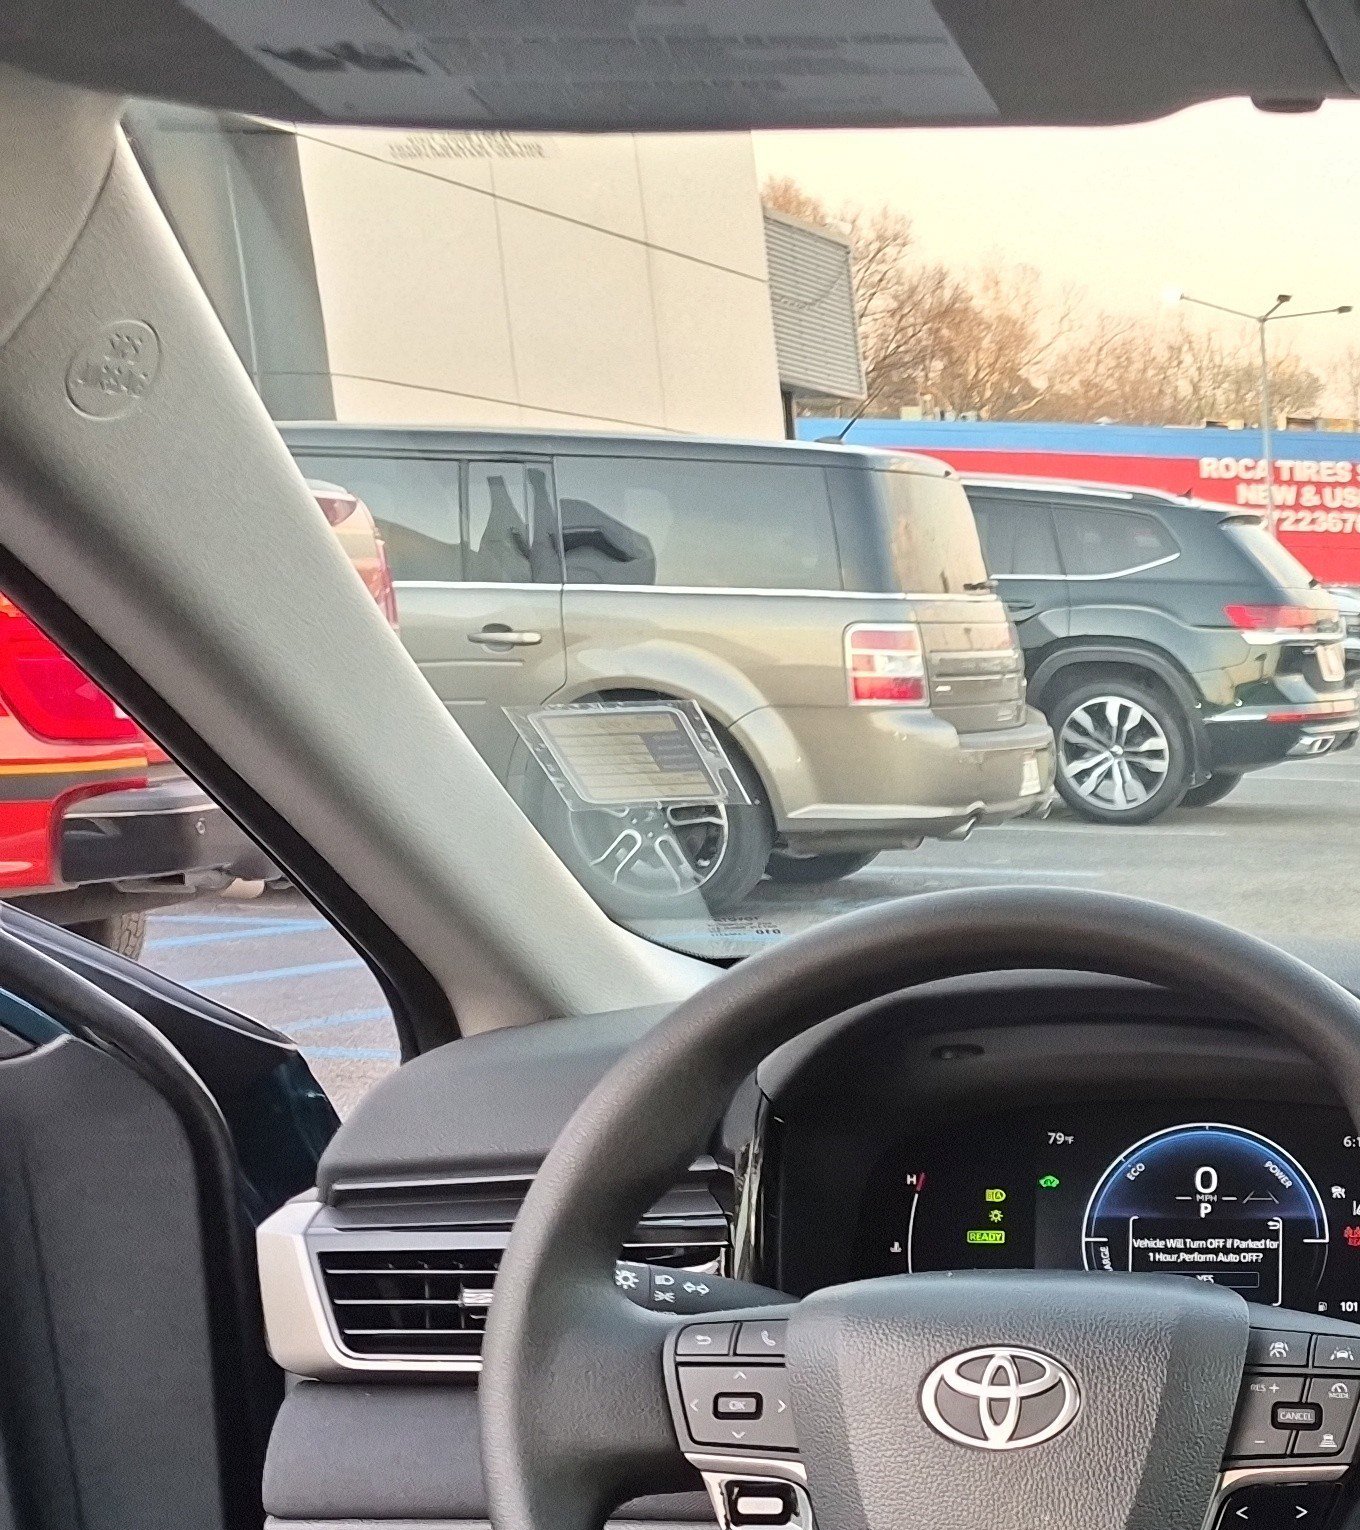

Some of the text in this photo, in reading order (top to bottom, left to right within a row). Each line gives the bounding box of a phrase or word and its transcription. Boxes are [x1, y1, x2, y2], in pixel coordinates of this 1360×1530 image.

[1199, 456, 1270, 481] ROCA
[1274, 459, 1353, 483] TIRES
[1236, 483, 1298, 507] NEW
[1299, 485, 1322, 507] &
[1126, 1162, 1146, 1181] ECO
[1263, 1160, 1293, 1189] POWER
[905, 1173, 917, 1186] H
[1194, 1165, 1218, 1195] 0
[1195, 1193, 1218, 1202] MPH
[1200, 1202, 1212, 1219] P
[969, 1232, 1002, 1242] READY
[1132, 1238, 1165, 1250] Vehicle
[1165, 1238, 1185, 1249] Will
[1185, 1238, 1206, 1249] Turn
[1208, 1239, 1225, 1249] OFF
[1233, 1238, 1264, 1249] Parked
[1265, 1238, 1280, 1249] for
[1101, 1246, 1112, 1271] ARGE
[1148, 1252, 1154, 1263] 1
[1217, 1253, 1240, 1263] Auto
[1240, 1253, 1263, 1264] OFF?
[1339, 1301, 1358, 1312] 101
[1280, 1410, 1313, 1421] CANCEL
